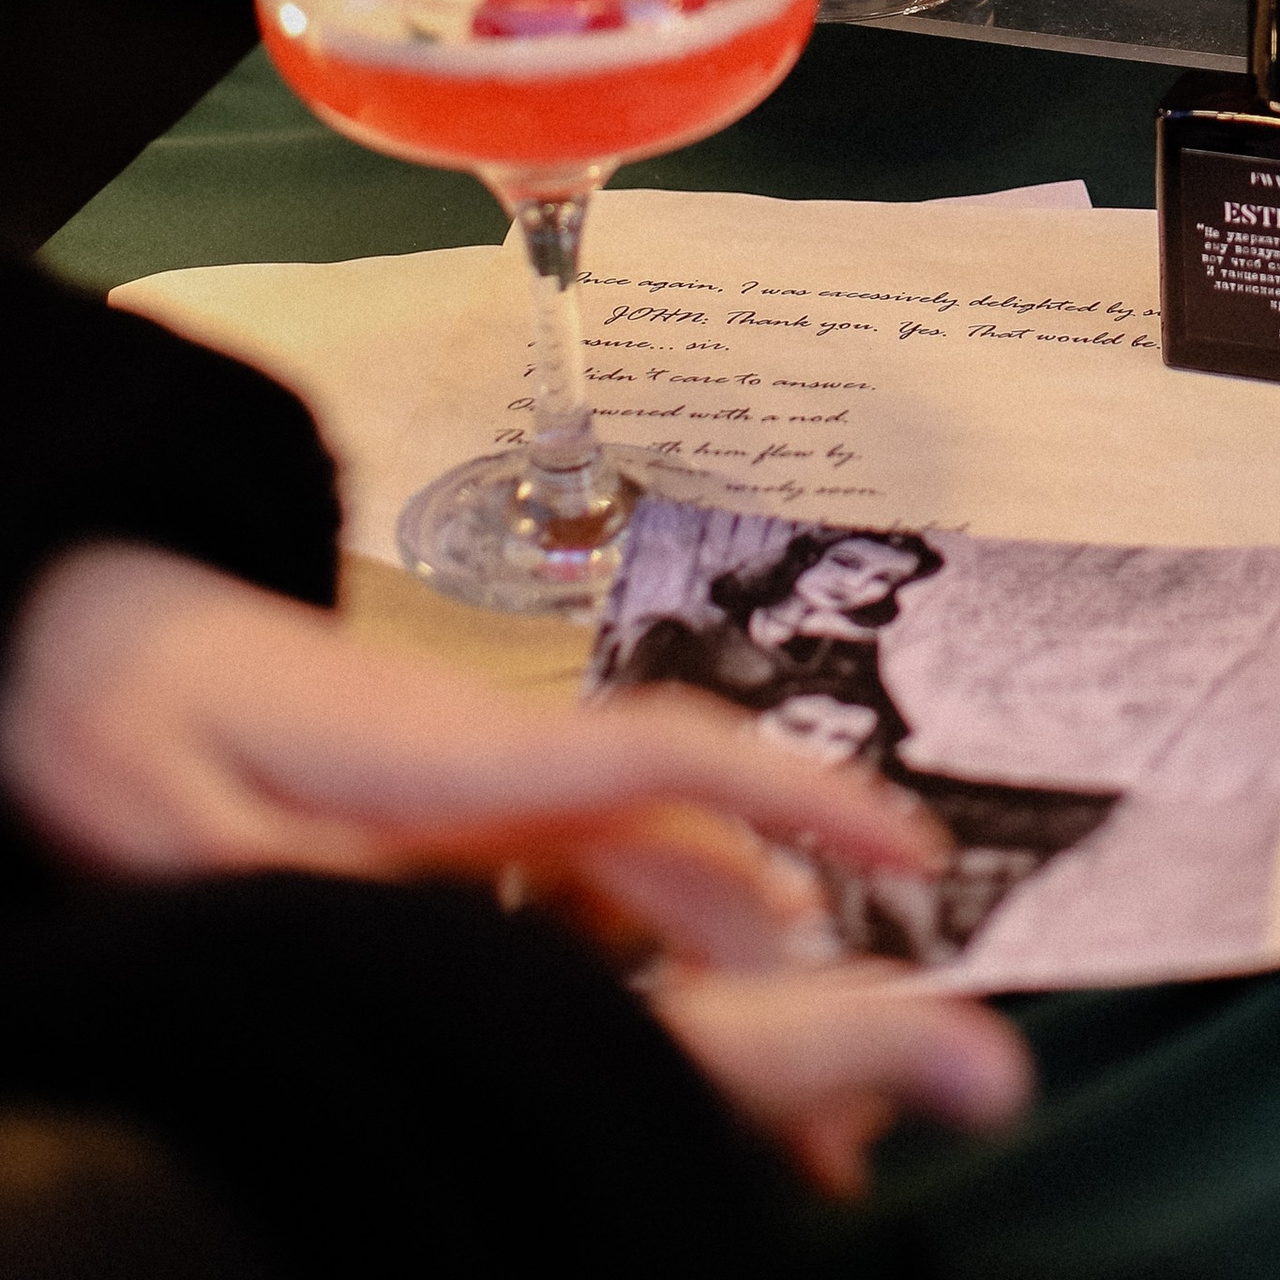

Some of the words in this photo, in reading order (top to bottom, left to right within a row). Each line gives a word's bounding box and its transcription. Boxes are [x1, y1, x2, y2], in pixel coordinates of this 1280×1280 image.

[1204, 241, 1228, 255] ему
[1201, 253, 1224, 265] вот
[1230, 257, 1262, 269] чтоб
[1206, 264, 1215, 276] И
[637, 279, 724, 293] again,
[740, 280, 759, 294] I
[761, 288, 812, 296] was
[818, 290, 960, 312] excessively
[968, 294, 1101, 314] delighted
[1106, 301, 1136, 322] by
[603, 305, 709, 325] JOHN:
[726, 310, 812, 327] Thank
[816, 321, 878, 337] you.
[898, 321, 947, 340] Yes.
[967, 324, 1035, 339] That
[1036, 331, 1126, 345] would
[685, 339, 730, 351] sir.
[669, 375, 730, 383] care
[733, 372, 761, 385] to
[772, 379, 876, 390] answer.
[689, 407, 751, 420] with
[761, 414, 780, 422] a
